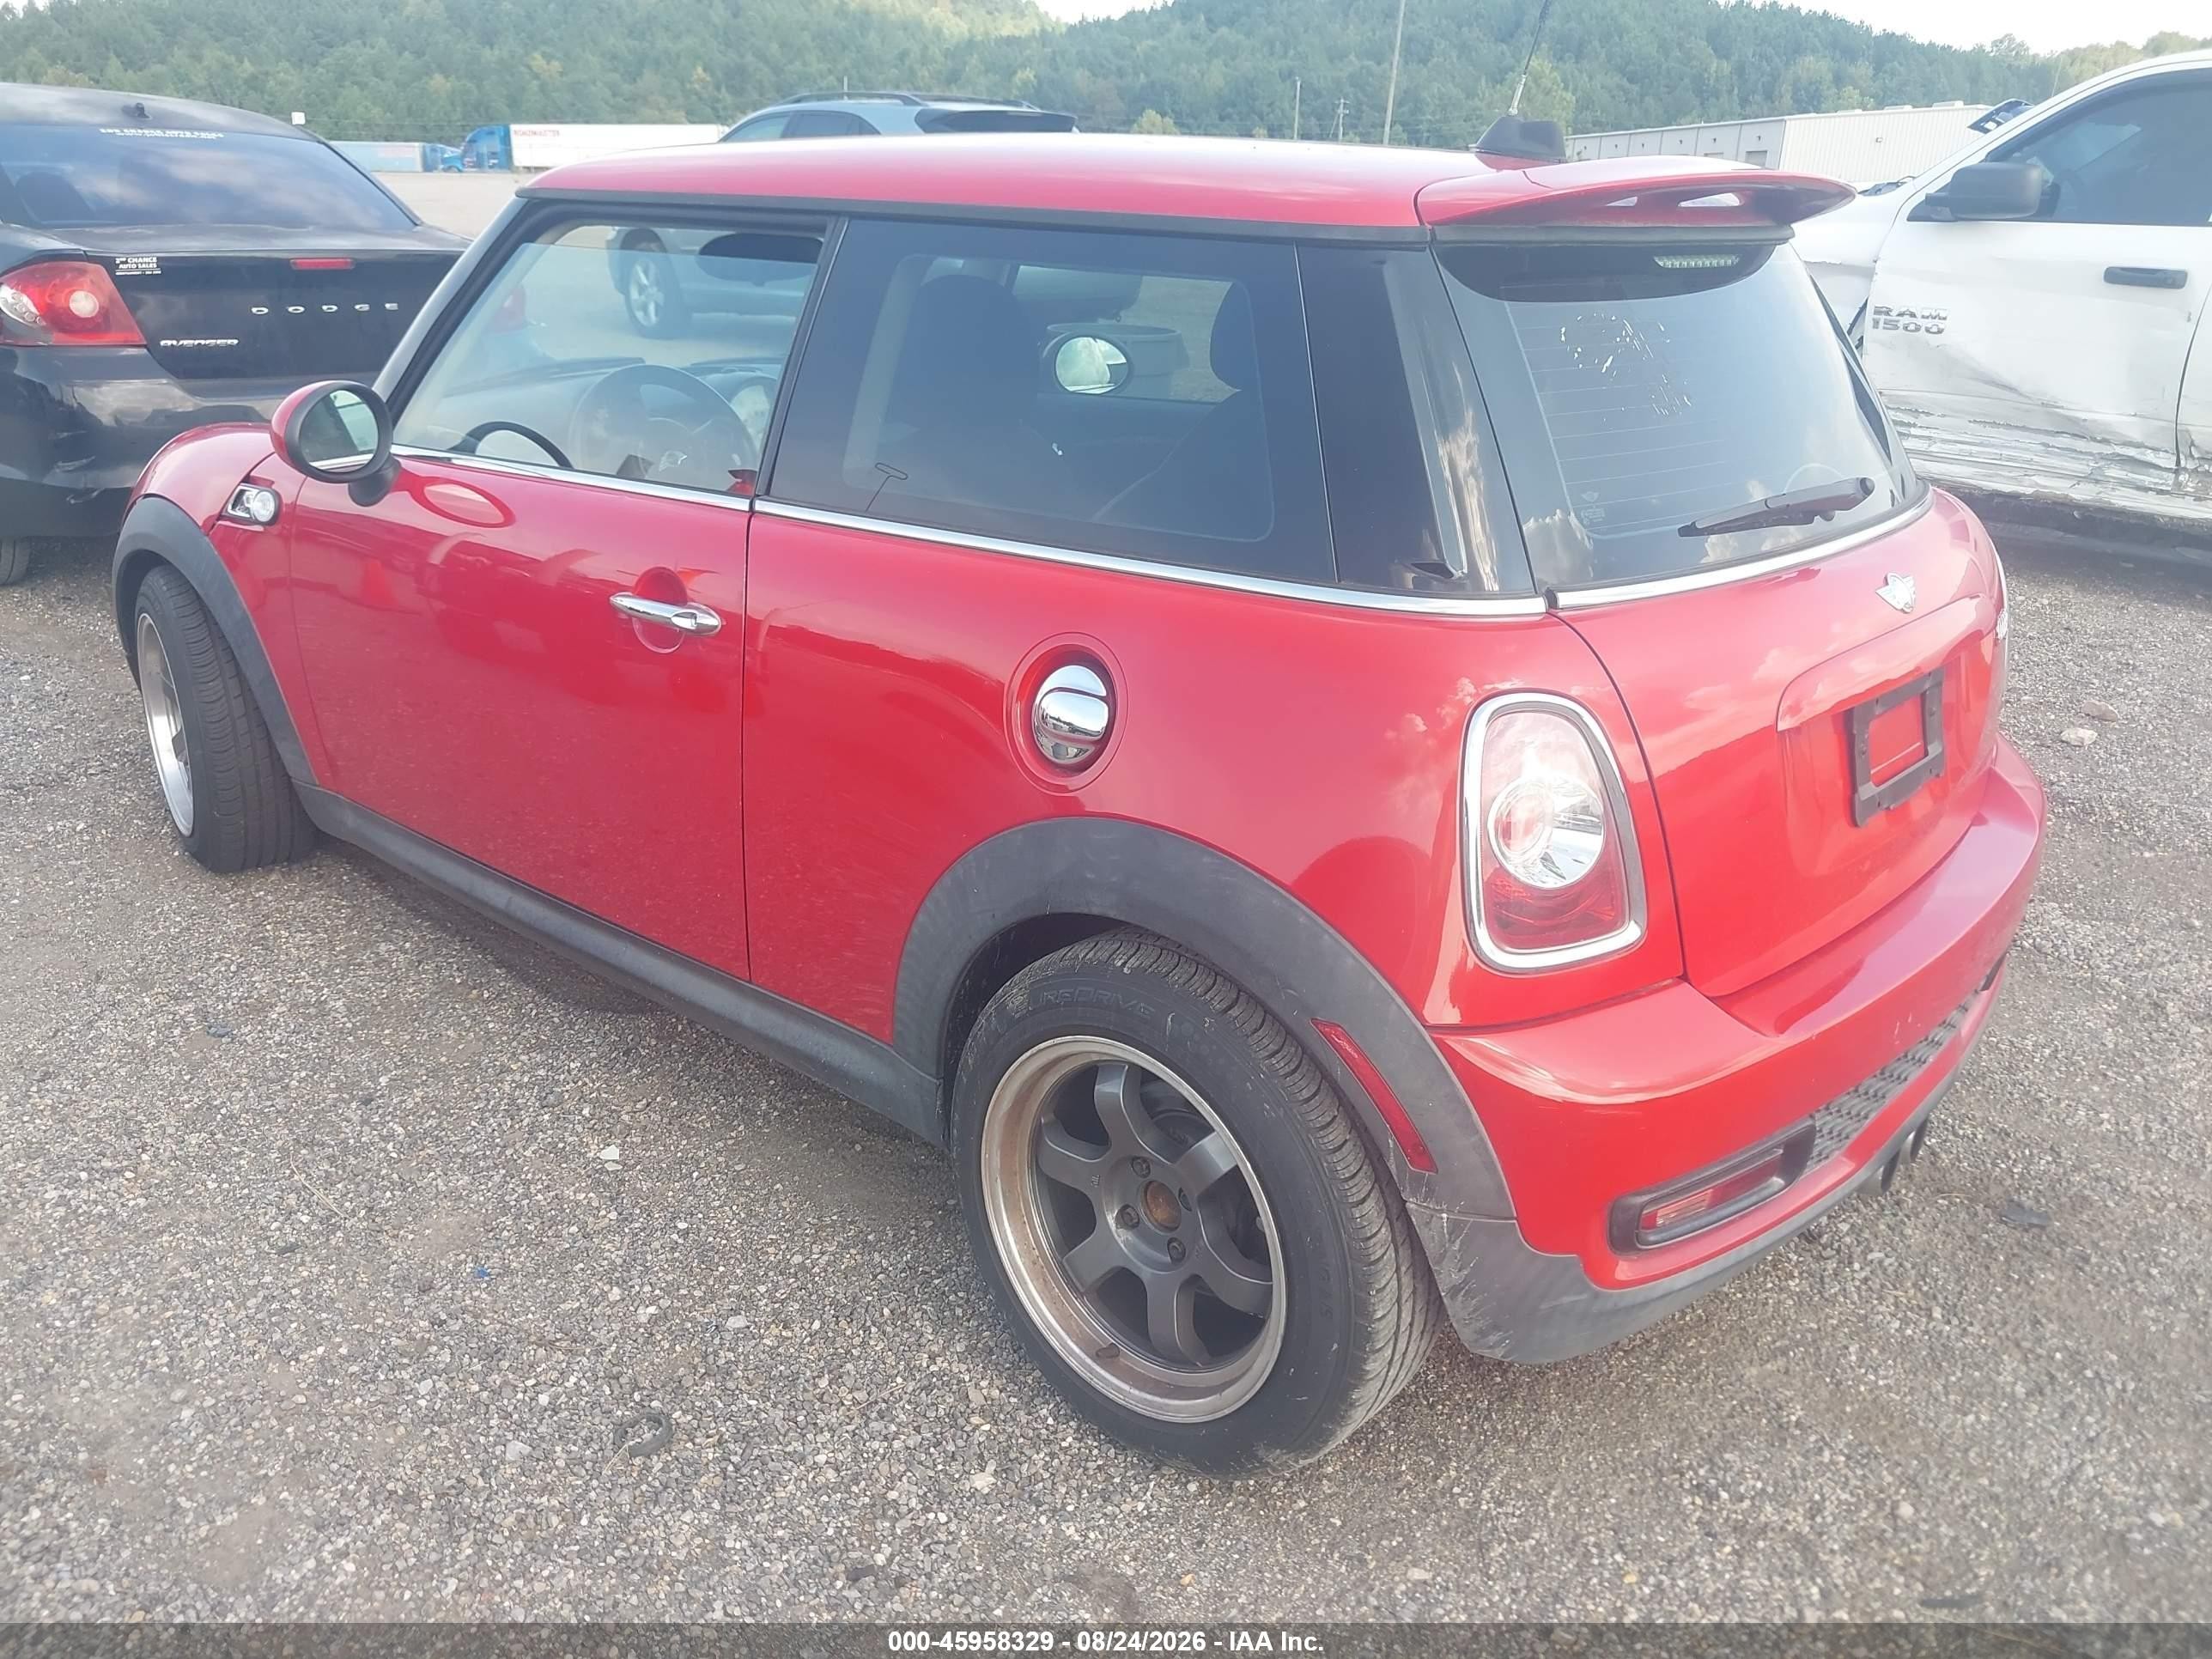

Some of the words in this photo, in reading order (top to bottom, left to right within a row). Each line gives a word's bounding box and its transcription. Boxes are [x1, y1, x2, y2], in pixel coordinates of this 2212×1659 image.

[1874, 306, 1948, 320] RAM
[1873, 318, 1945, 334] 1500
[160, 339, 240, 348] AVENGER
